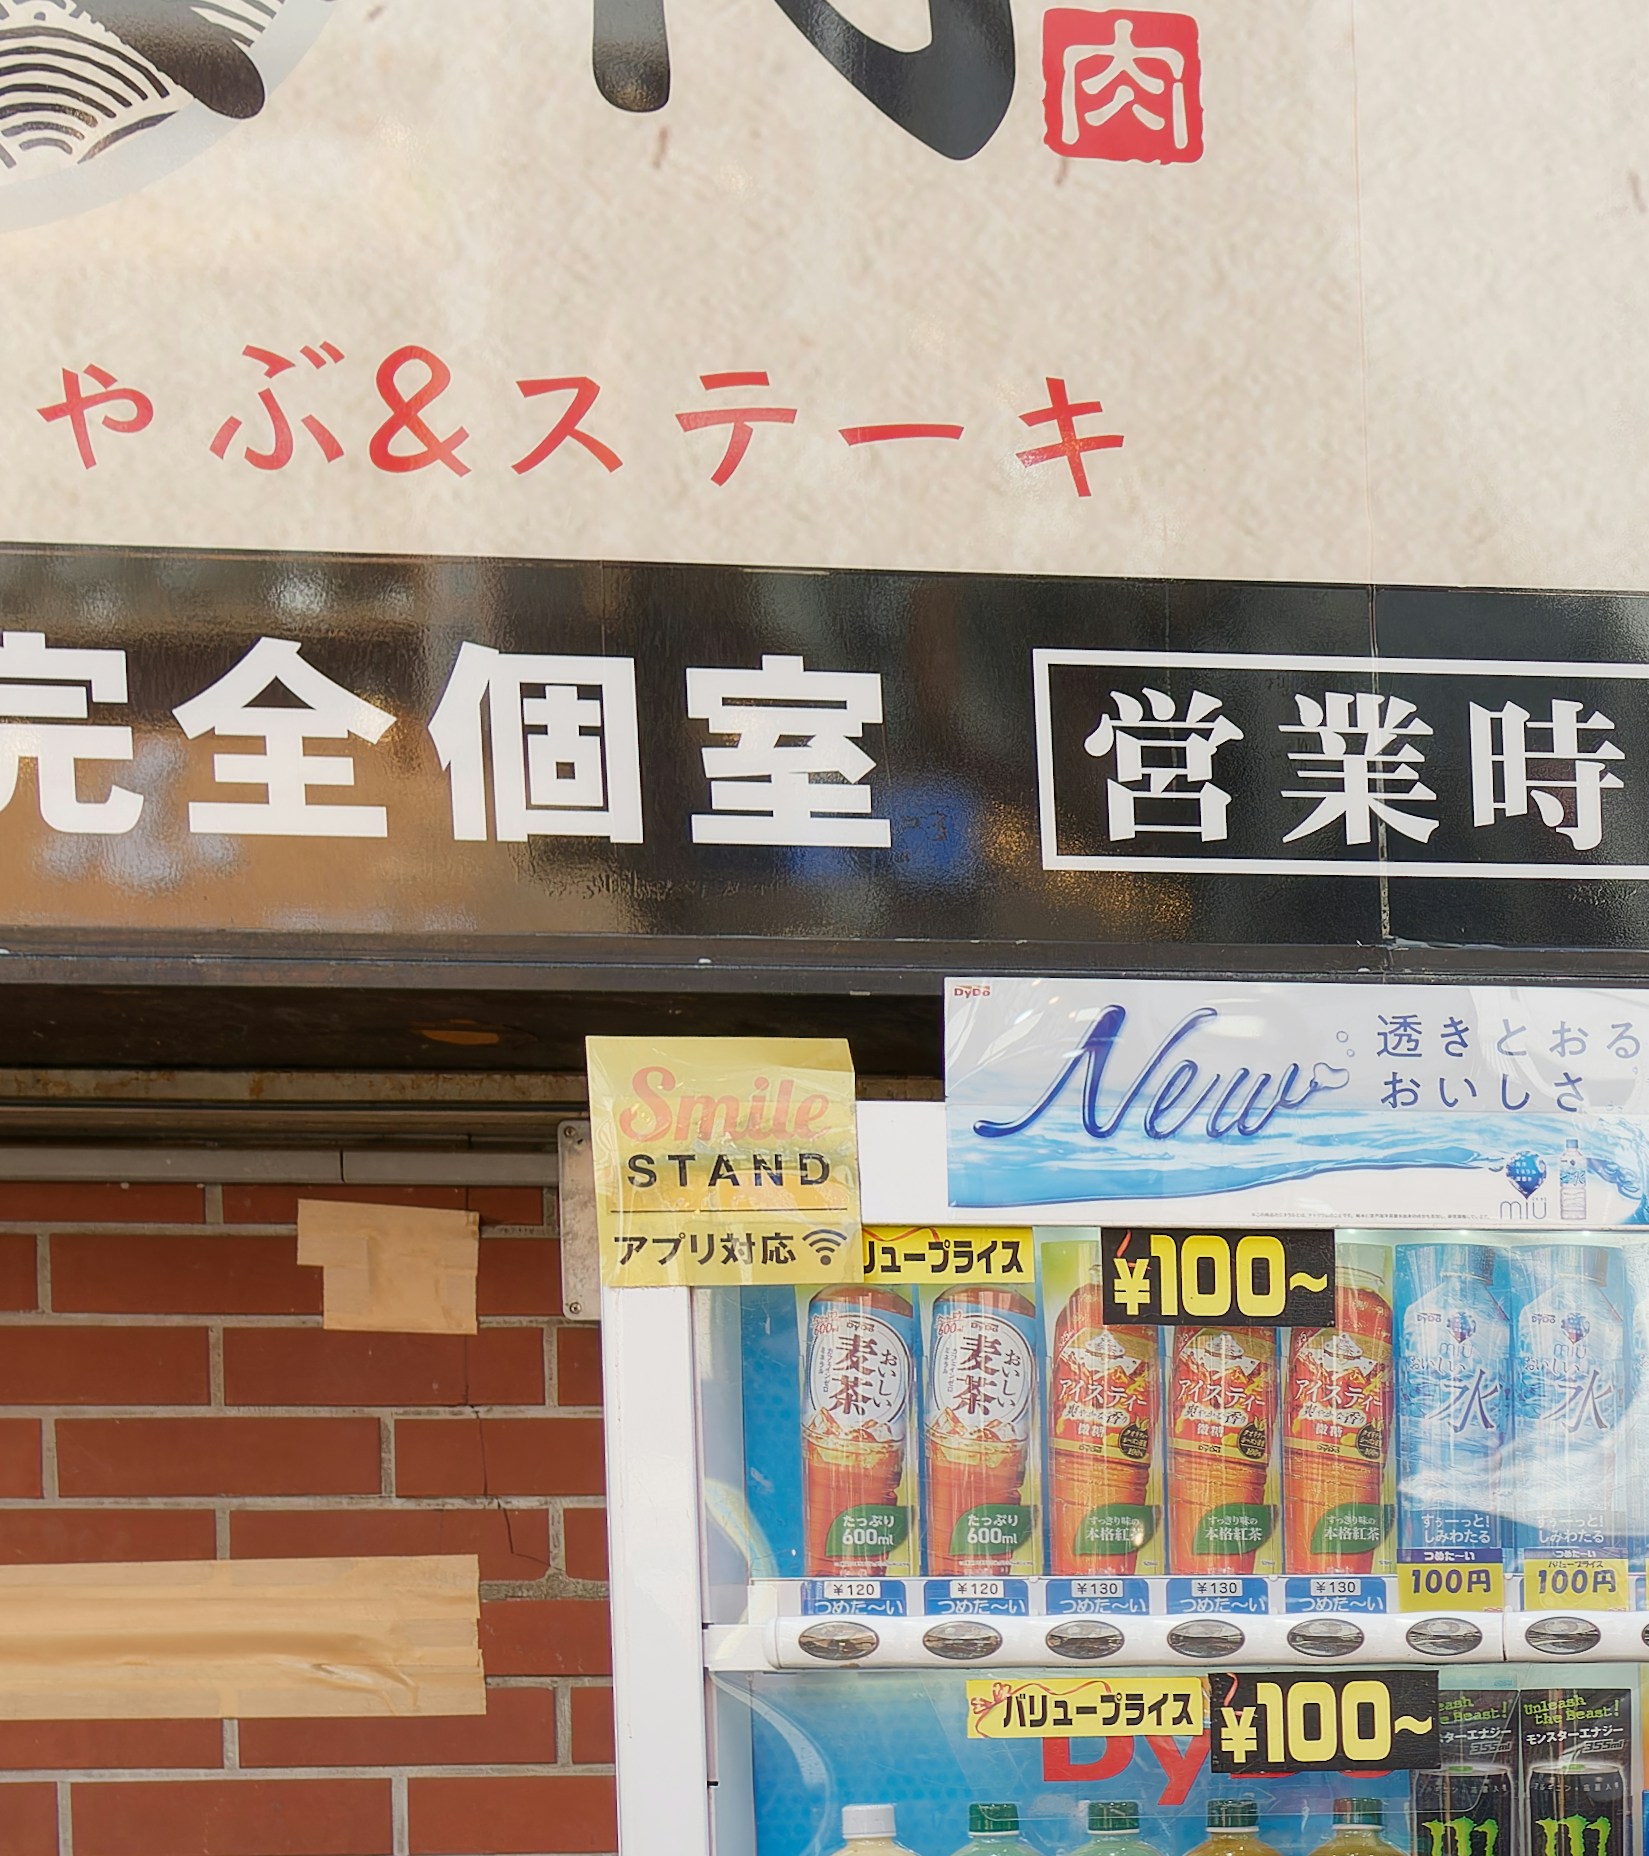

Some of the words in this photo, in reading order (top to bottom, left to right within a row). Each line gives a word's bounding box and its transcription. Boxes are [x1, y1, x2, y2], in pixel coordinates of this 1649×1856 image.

[1059, 18, 1188, 150] 肉
[38, 343, 1125, 499] やぶ&ステーキ
[0, 631, 893, 850] 完全個室
[953, 985, 991, 999] DyDo
[1376, 1013, 1642, 1061] 透きとおる
[972, 1003, 1318, 1140] New
[619, 1065, 832, 1144] Smile
[1383, 1068, 1586, 1113] おいしさ
[626, 1153, 831, 1188] STAND
[613, 1232, 797, 1267] アプリ対応
[832, 1334, 878, 1415] 麦茶
[956, 1333, 1002, 1414] 麦茶
[1436, 1372, 1502, 1430] 水
[842, 1514, 895, 1528] たっぷり
[842, 1528, 894, 1546] 600ml
[1324, 1525, 1380, 1542] 本格紅茶
[833, 1583, 876, 1596] ¥120
[1077, 1583, 1118, 1596] ¥130
[1411, 1570, 1492, 1596] 100円
[1004, 1694, 1194, 1727] バリュープライス
[1524, 1697, 1586, 1718] Unleash
[1573, 1702, 1621, 1724] Beast!
[1526, 1726, 1624, 1744] モンスターエナジー
